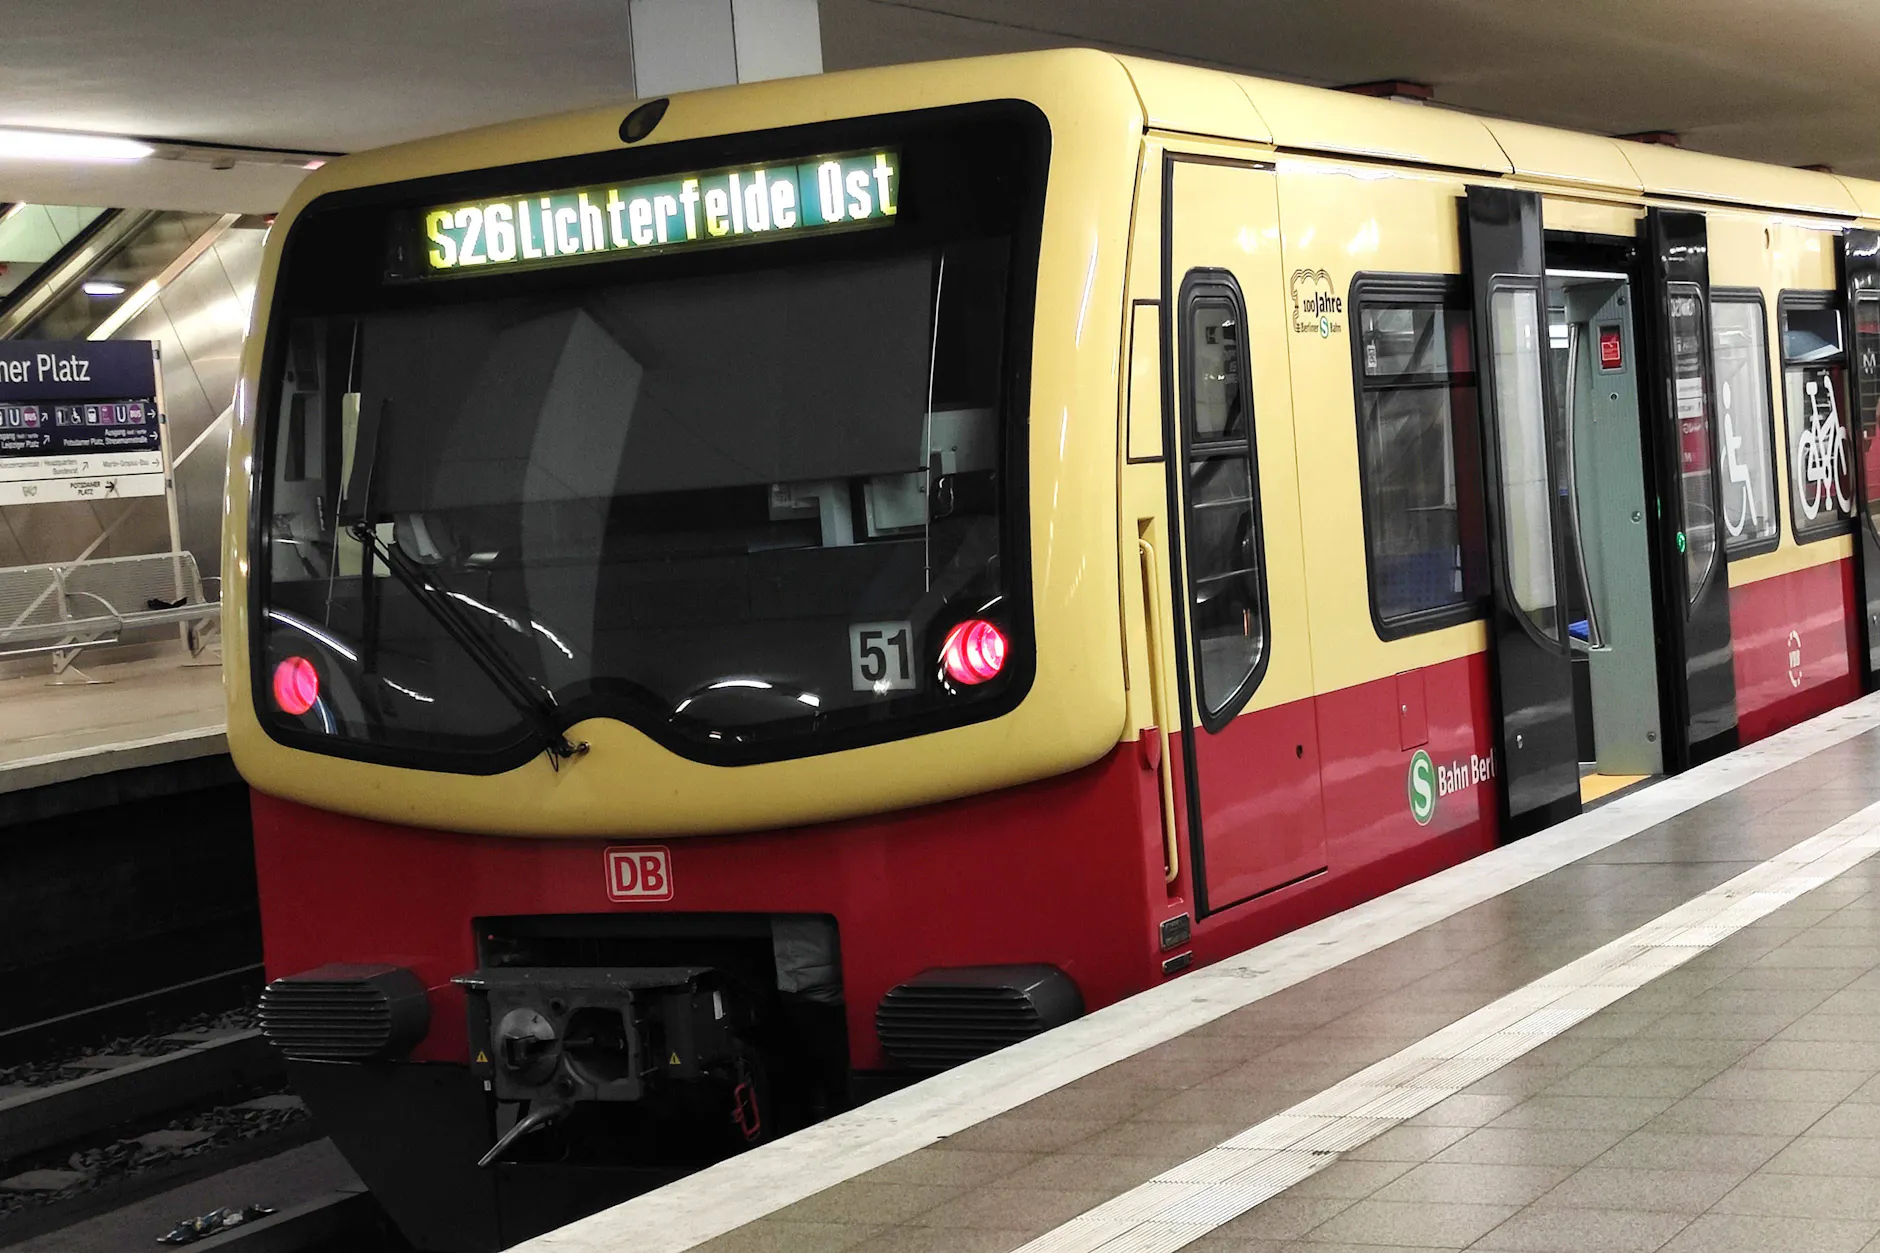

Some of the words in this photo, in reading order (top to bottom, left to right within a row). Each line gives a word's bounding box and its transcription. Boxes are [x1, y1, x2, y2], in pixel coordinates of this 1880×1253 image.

[517, 169, 797, 258] Lichterfelde
[817, 153, 898, 223] Ost
[37, 353, 91, 382] Platz
[859, 629, 911, 682] 51
[1438, 760, 1469, 797] Bahn
[614, 855, 664, 893] DB
